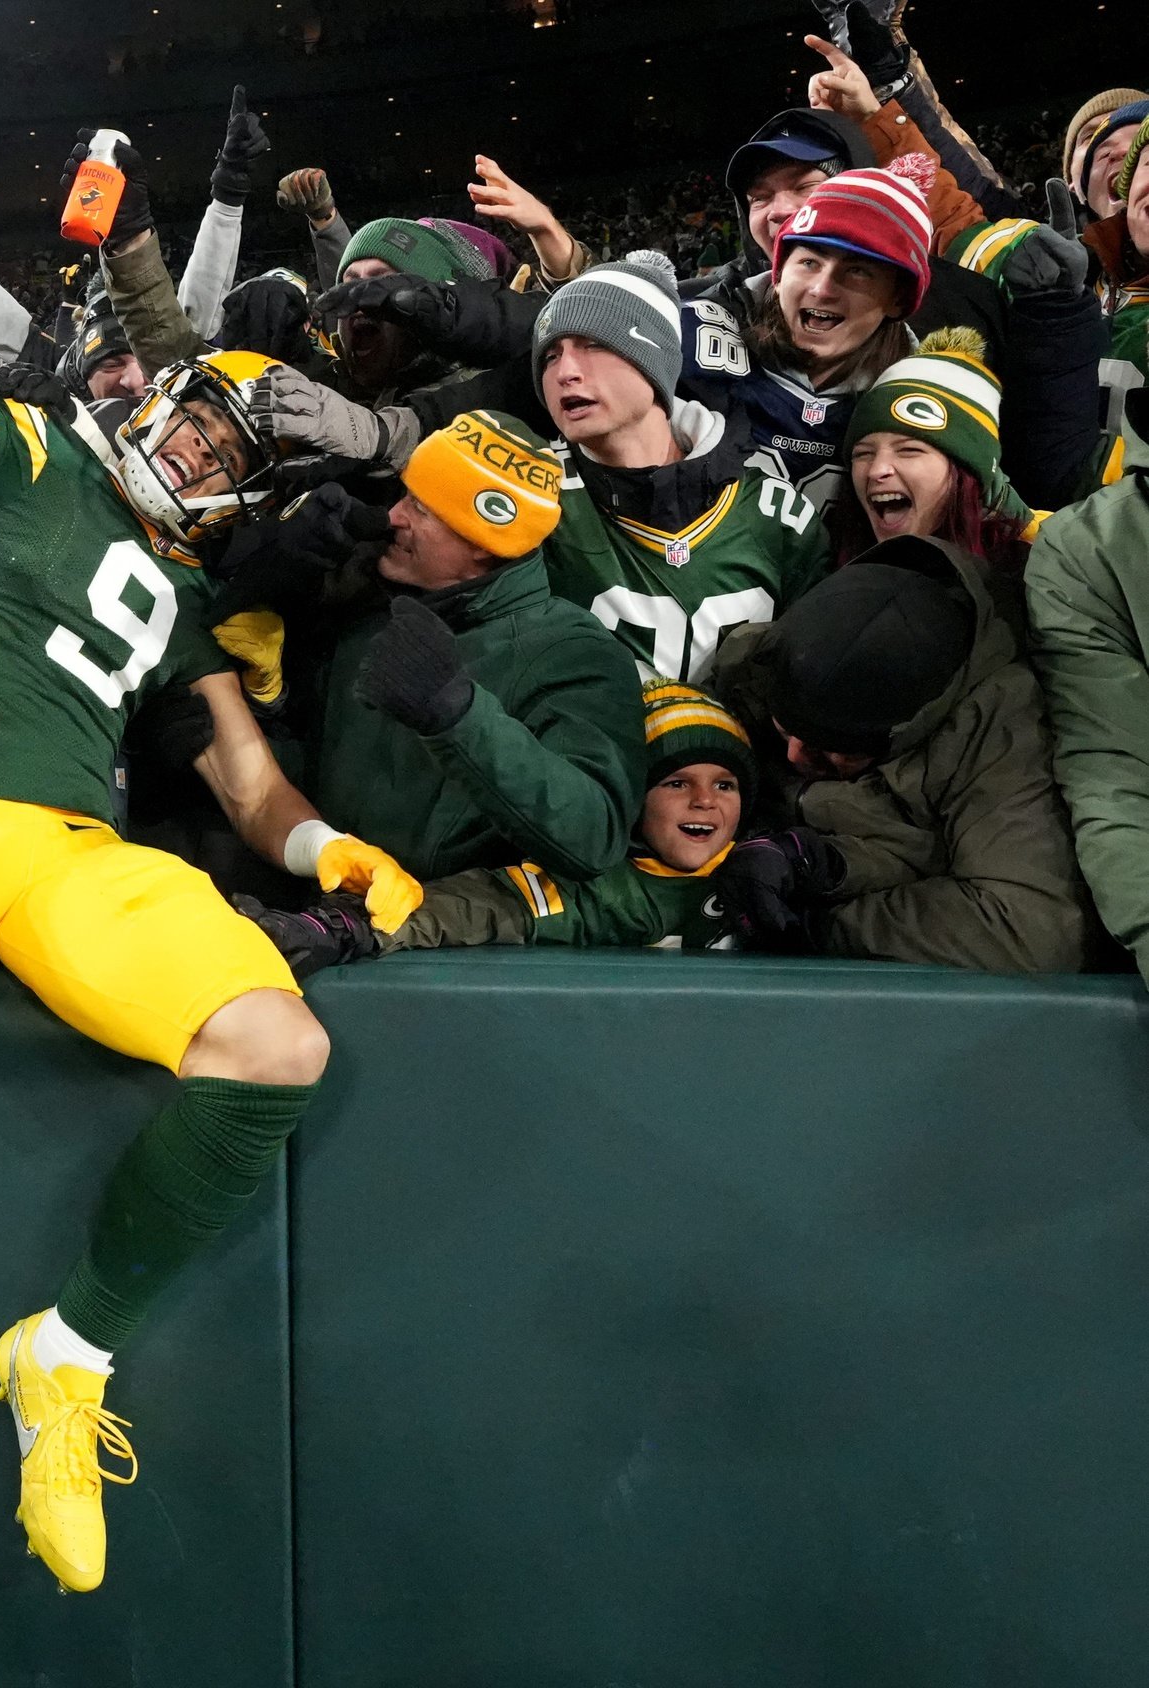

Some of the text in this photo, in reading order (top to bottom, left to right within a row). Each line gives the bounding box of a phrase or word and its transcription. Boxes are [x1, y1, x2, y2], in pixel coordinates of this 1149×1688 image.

[791, 205, 818, 234] OU
[685, 299, 751, 377] 88
[446, 420, 561, 496] PACKERS
[771, 434, 836, 456] COWBOYS
[474, 489, 517, 525] G
[45, 540, 179, 709] 9
